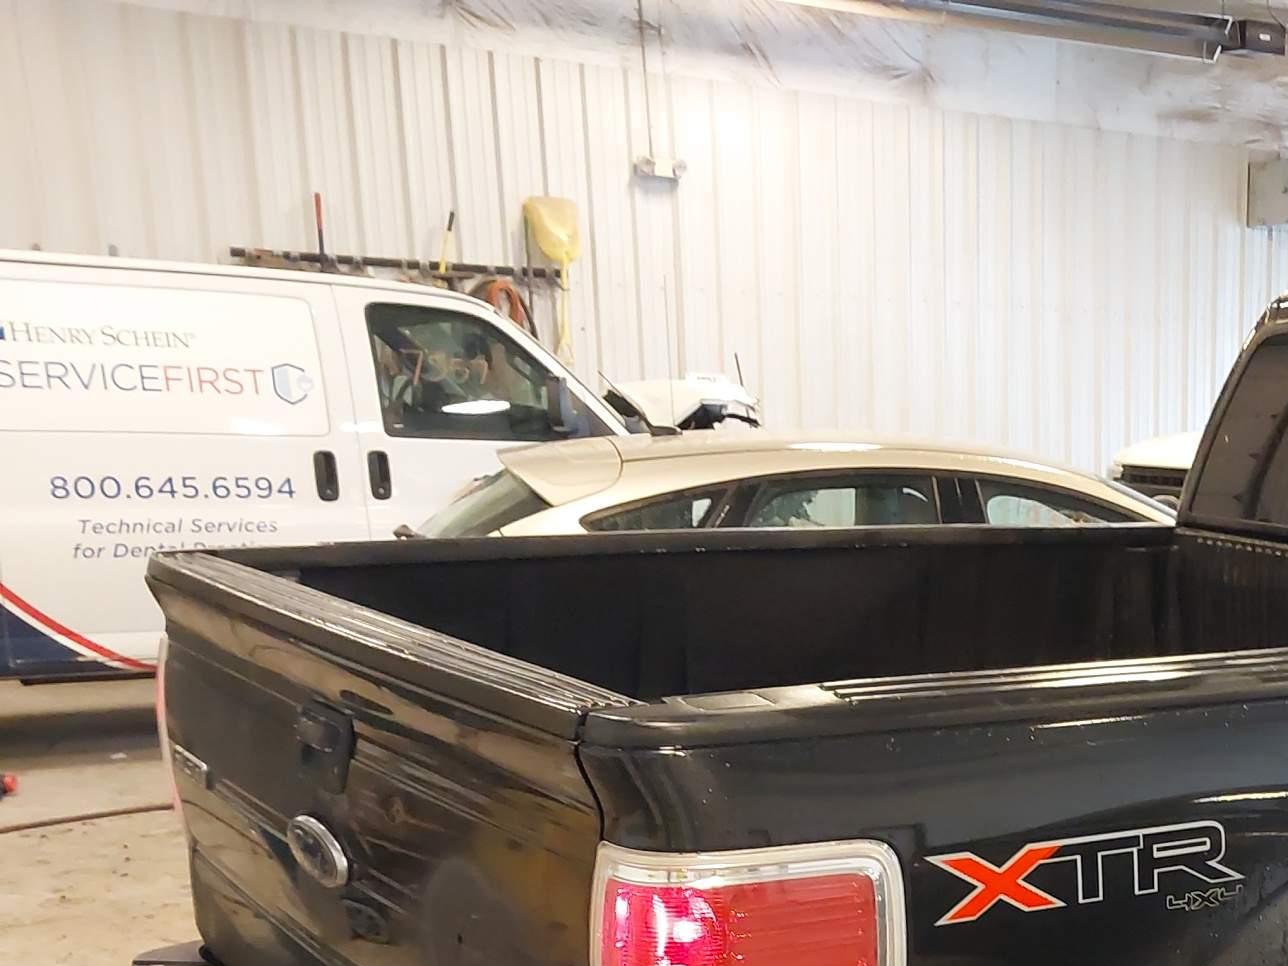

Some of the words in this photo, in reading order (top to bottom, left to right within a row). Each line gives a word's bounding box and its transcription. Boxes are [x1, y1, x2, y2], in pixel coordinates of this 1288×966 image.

[0, 360, 264, 396] SERVICEFIRST
[50, 475, 296, 500] 800.645.6594
[78, 518, 183, 535] Technical
[190, 518, 278, 534] Services
[72, 543, 106, 559] for
[923, 820, 1245, 927] XTR
